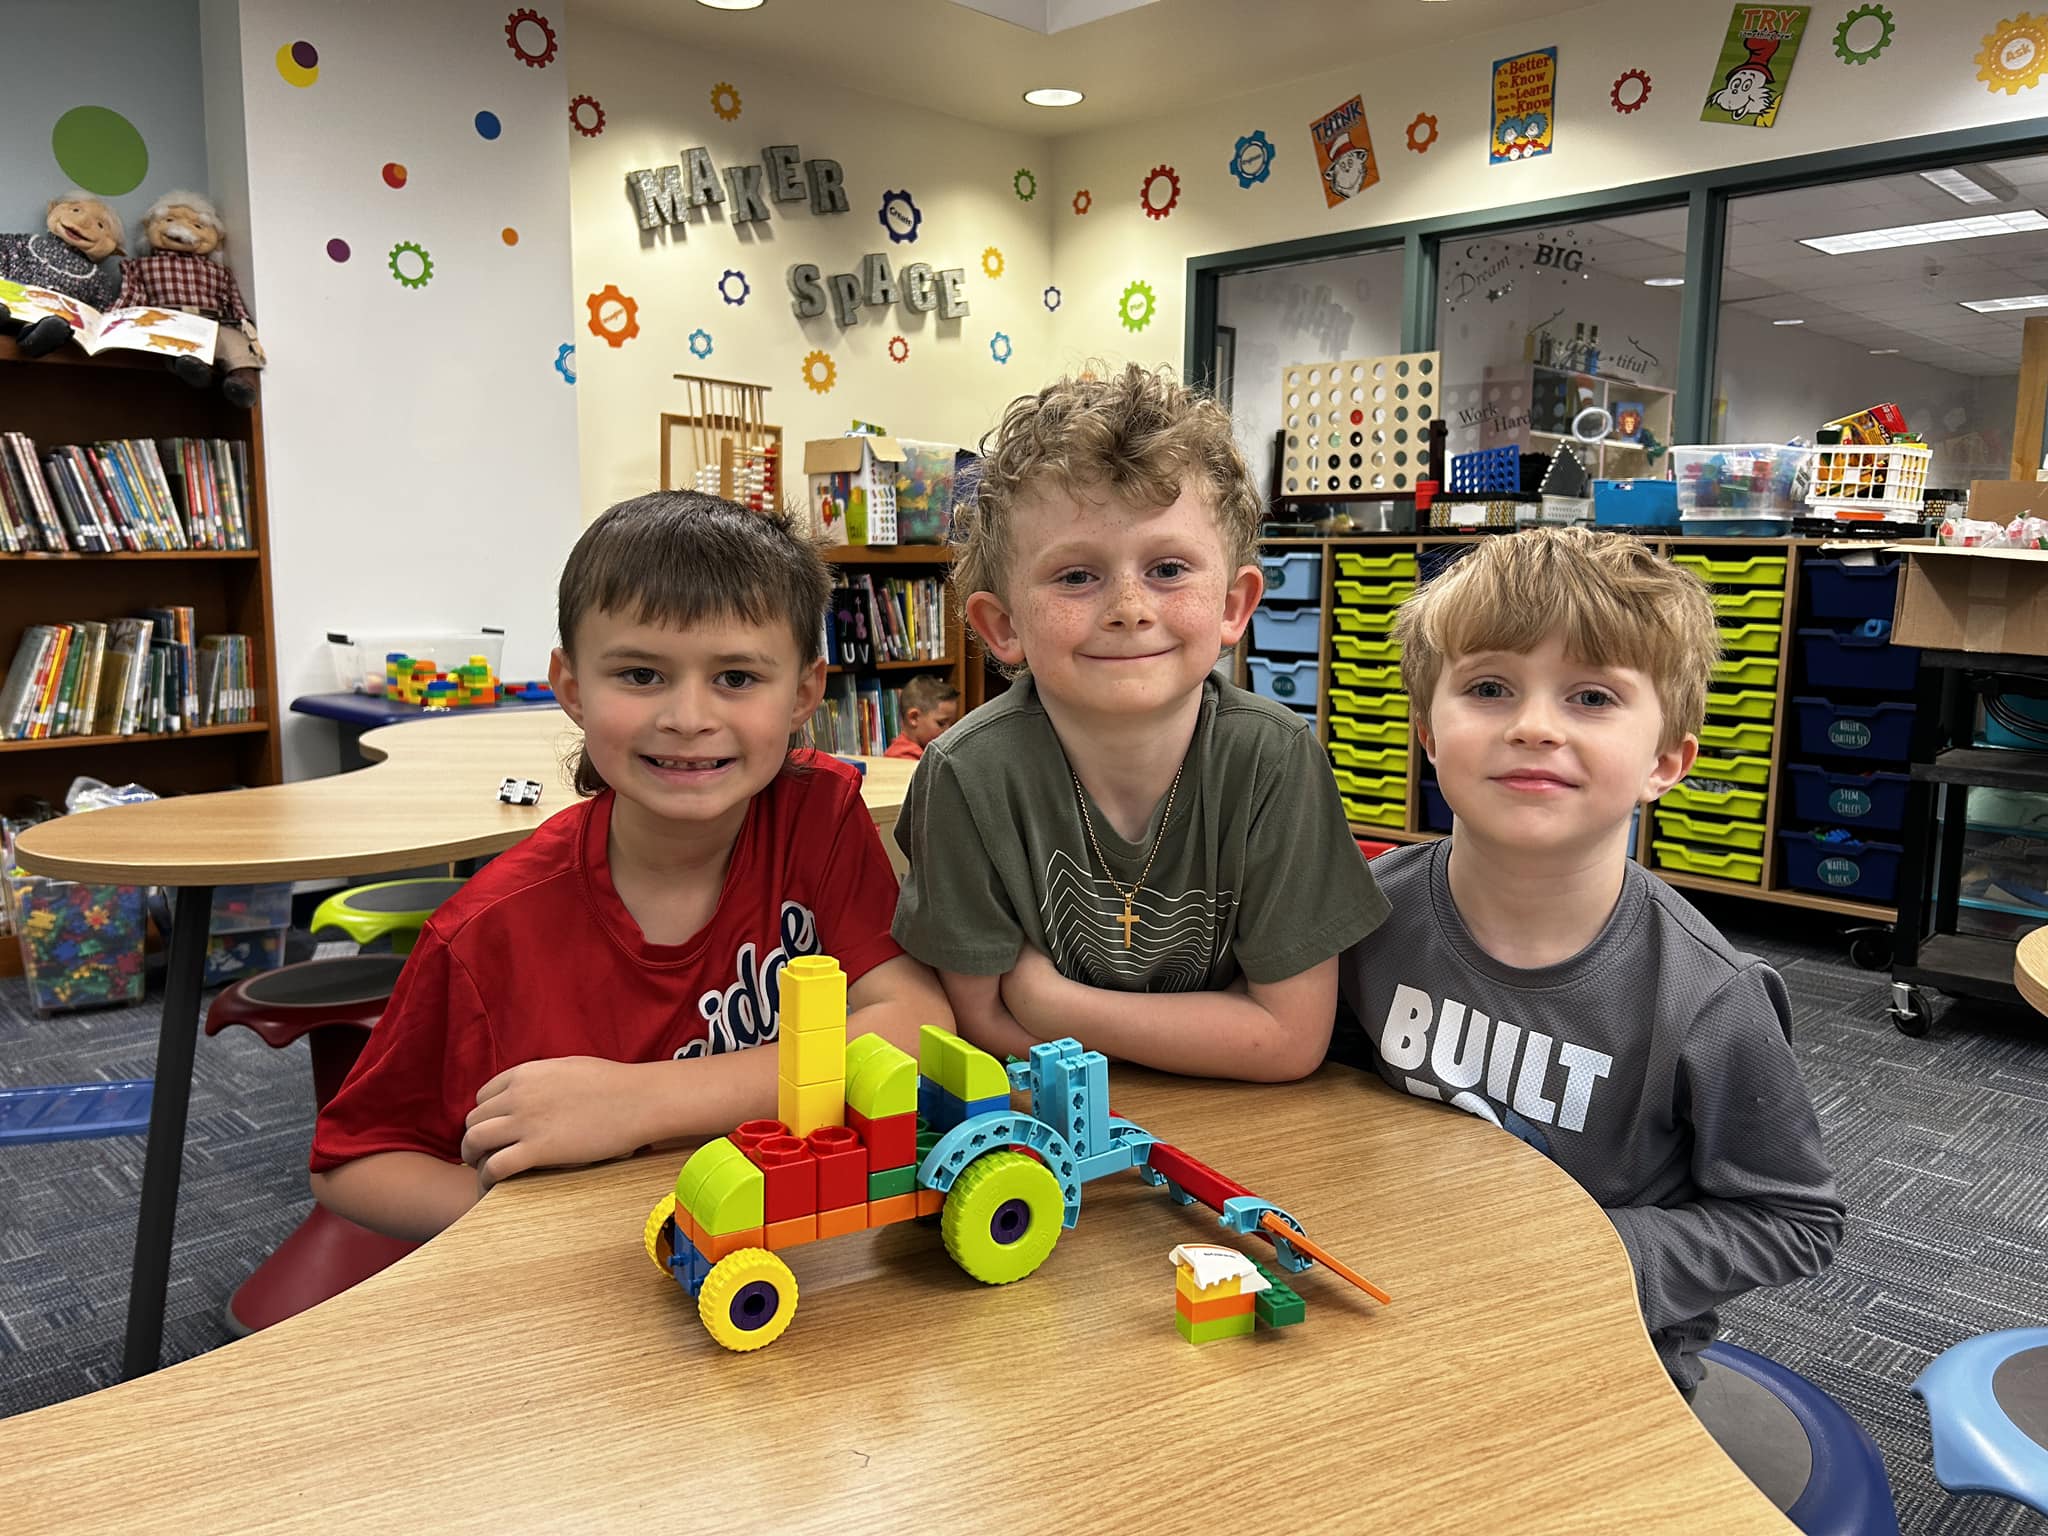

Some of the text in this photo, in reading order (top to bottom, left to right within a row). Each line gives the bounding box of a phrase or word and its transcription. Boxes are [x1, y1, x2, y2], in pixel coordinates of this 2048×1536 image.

[1742, 8, 1800, 32] TRY
[2006, 43, 2031, 63] Ask
[1510, 57, 1551, 74] Better
[1510, 72, 1546, 89] Know
[1516, 84, 1550, 100] Learn
[1517, 98, 1552, 114] Know
[1311, 101, 1363, 142] THINK
[625, 145, 850, 231] MAKER
[1533, 243, 1584, 272] BIG
[1459, 402, 1497, 424] Work
[1495, 408, 1533, 432] Hard
[843, 642, 869, 664] U V
[1840, 788, 1859, 800] STEM
[1380, 983, 1613, 1133] BUILT
